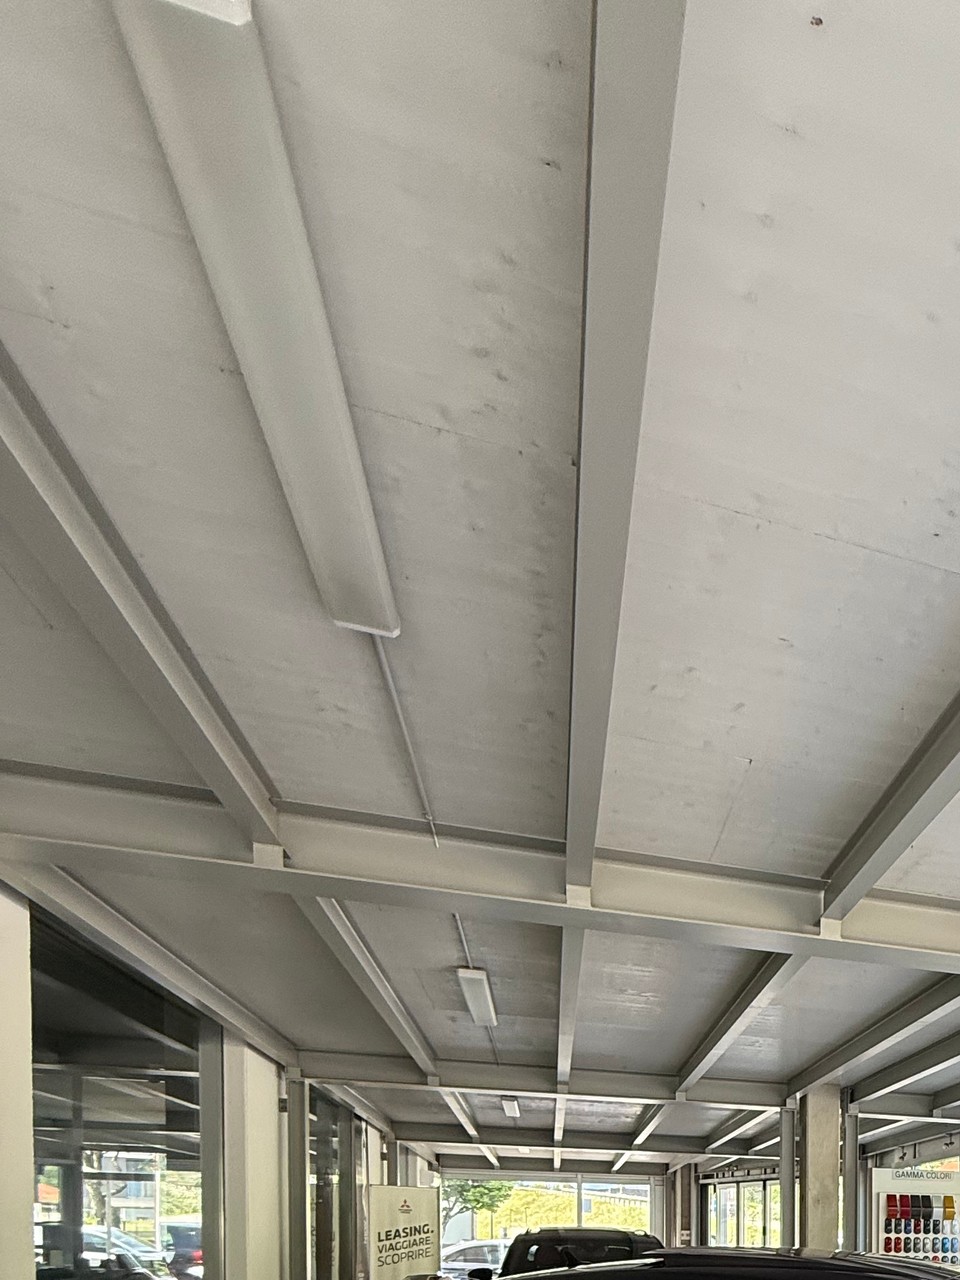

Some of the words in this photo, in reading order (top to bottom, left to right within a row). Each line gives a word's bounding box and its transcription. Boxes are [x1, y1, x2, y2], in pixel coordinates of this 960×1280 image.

[895, 1171, 924, 1179] GAMMA
[926, 1172, 951, 1180] COLORI
[377, 1224, 434, 1242] LEASING.
[377, 1236, 434, 1254] VIAGGIARE.
[377, 1247, 434, 1267] SCOPRIRE.
